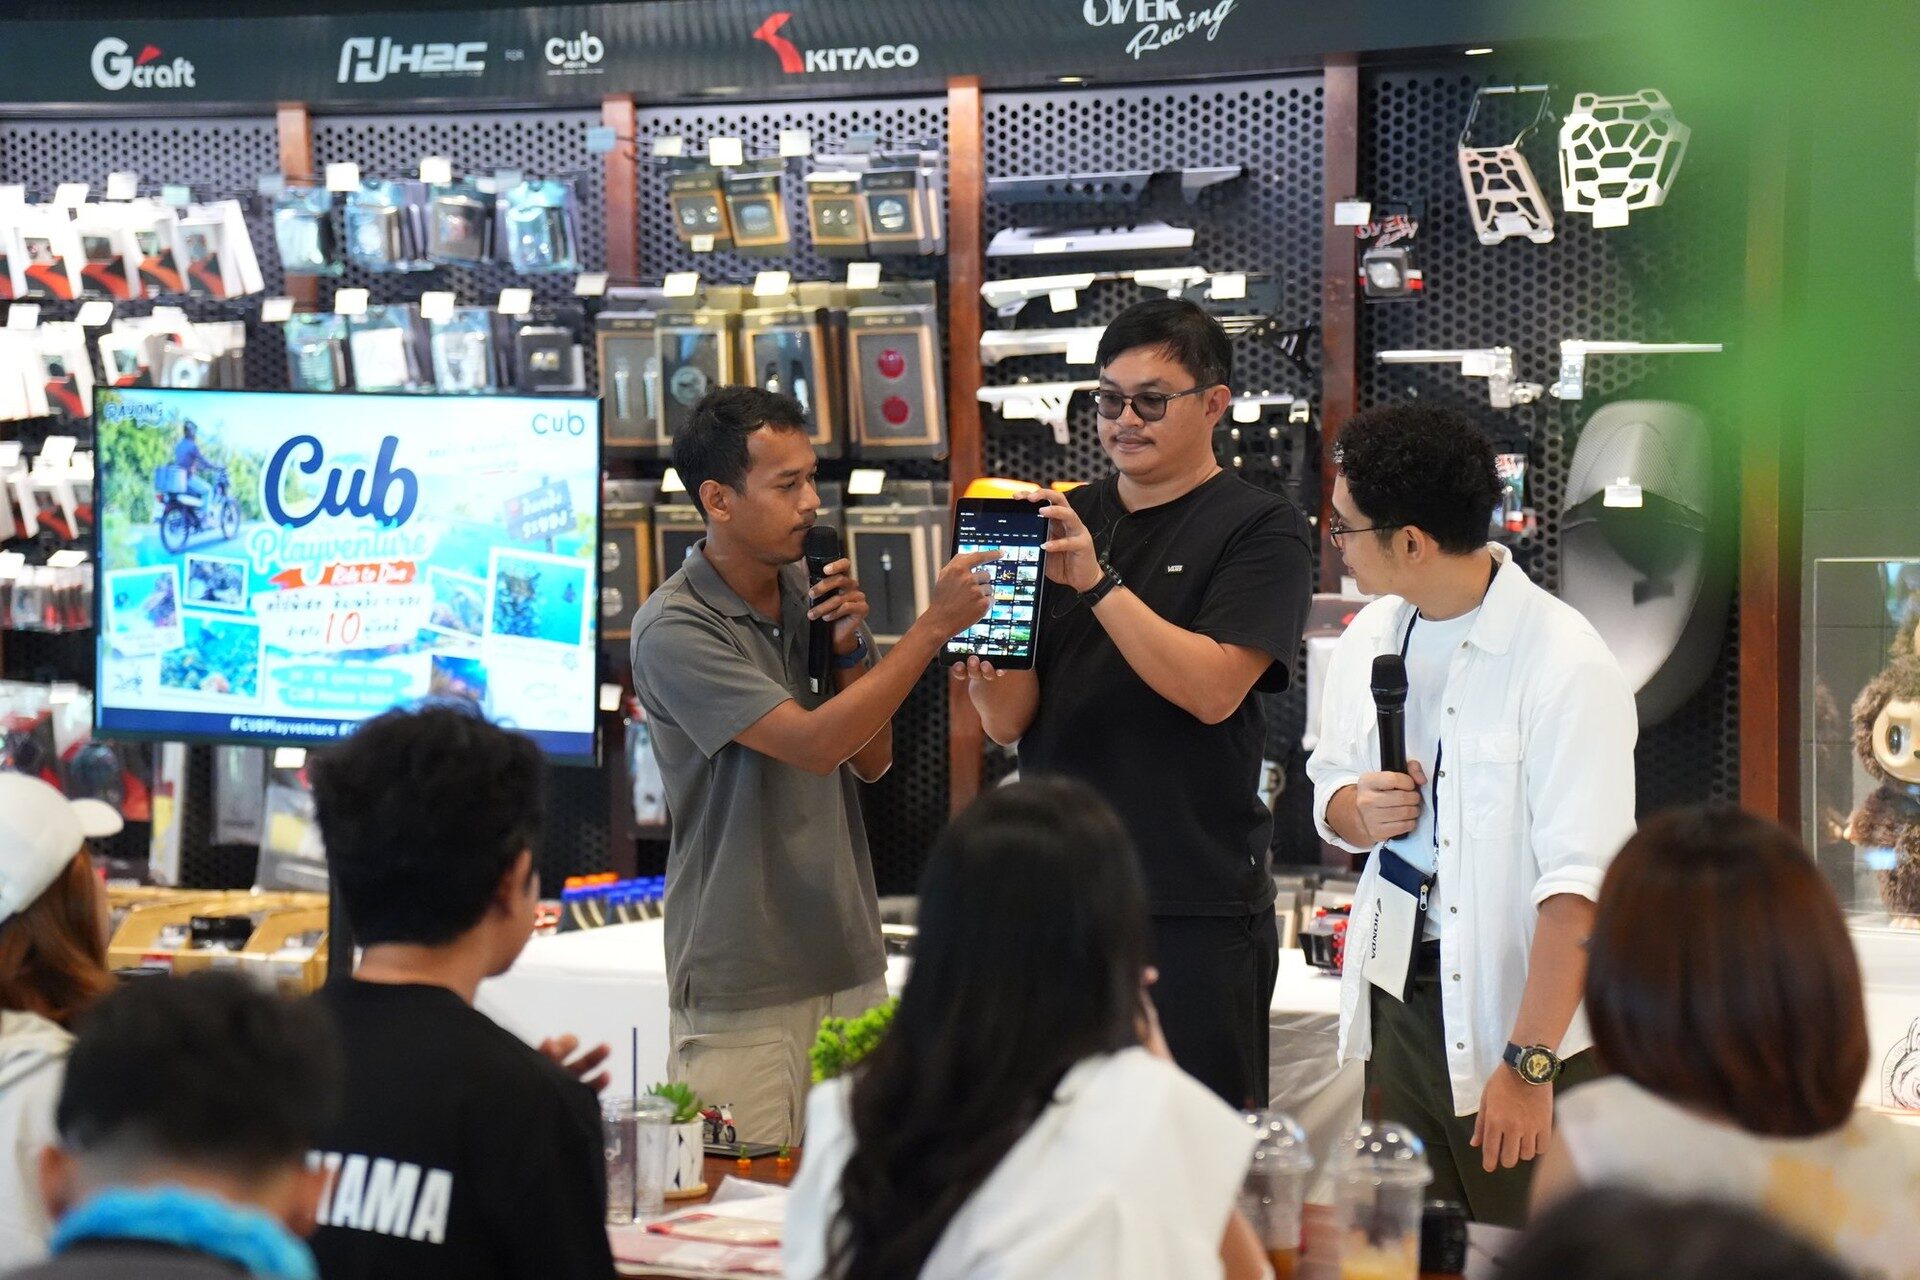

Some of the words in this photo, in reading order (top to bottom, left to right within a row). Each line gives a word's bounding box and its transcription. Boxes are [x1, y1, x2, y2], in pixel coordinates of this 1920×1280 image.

[1125, 0, 1238, 60] Racing
[805, 43, 920, 73] KITACO
[264, 434, 419, 529] Cub
[252, 525, 427, 581] Playventure
[326, 611, 361, 644] 10
[1370, 912, 1380, 960] HONDA
